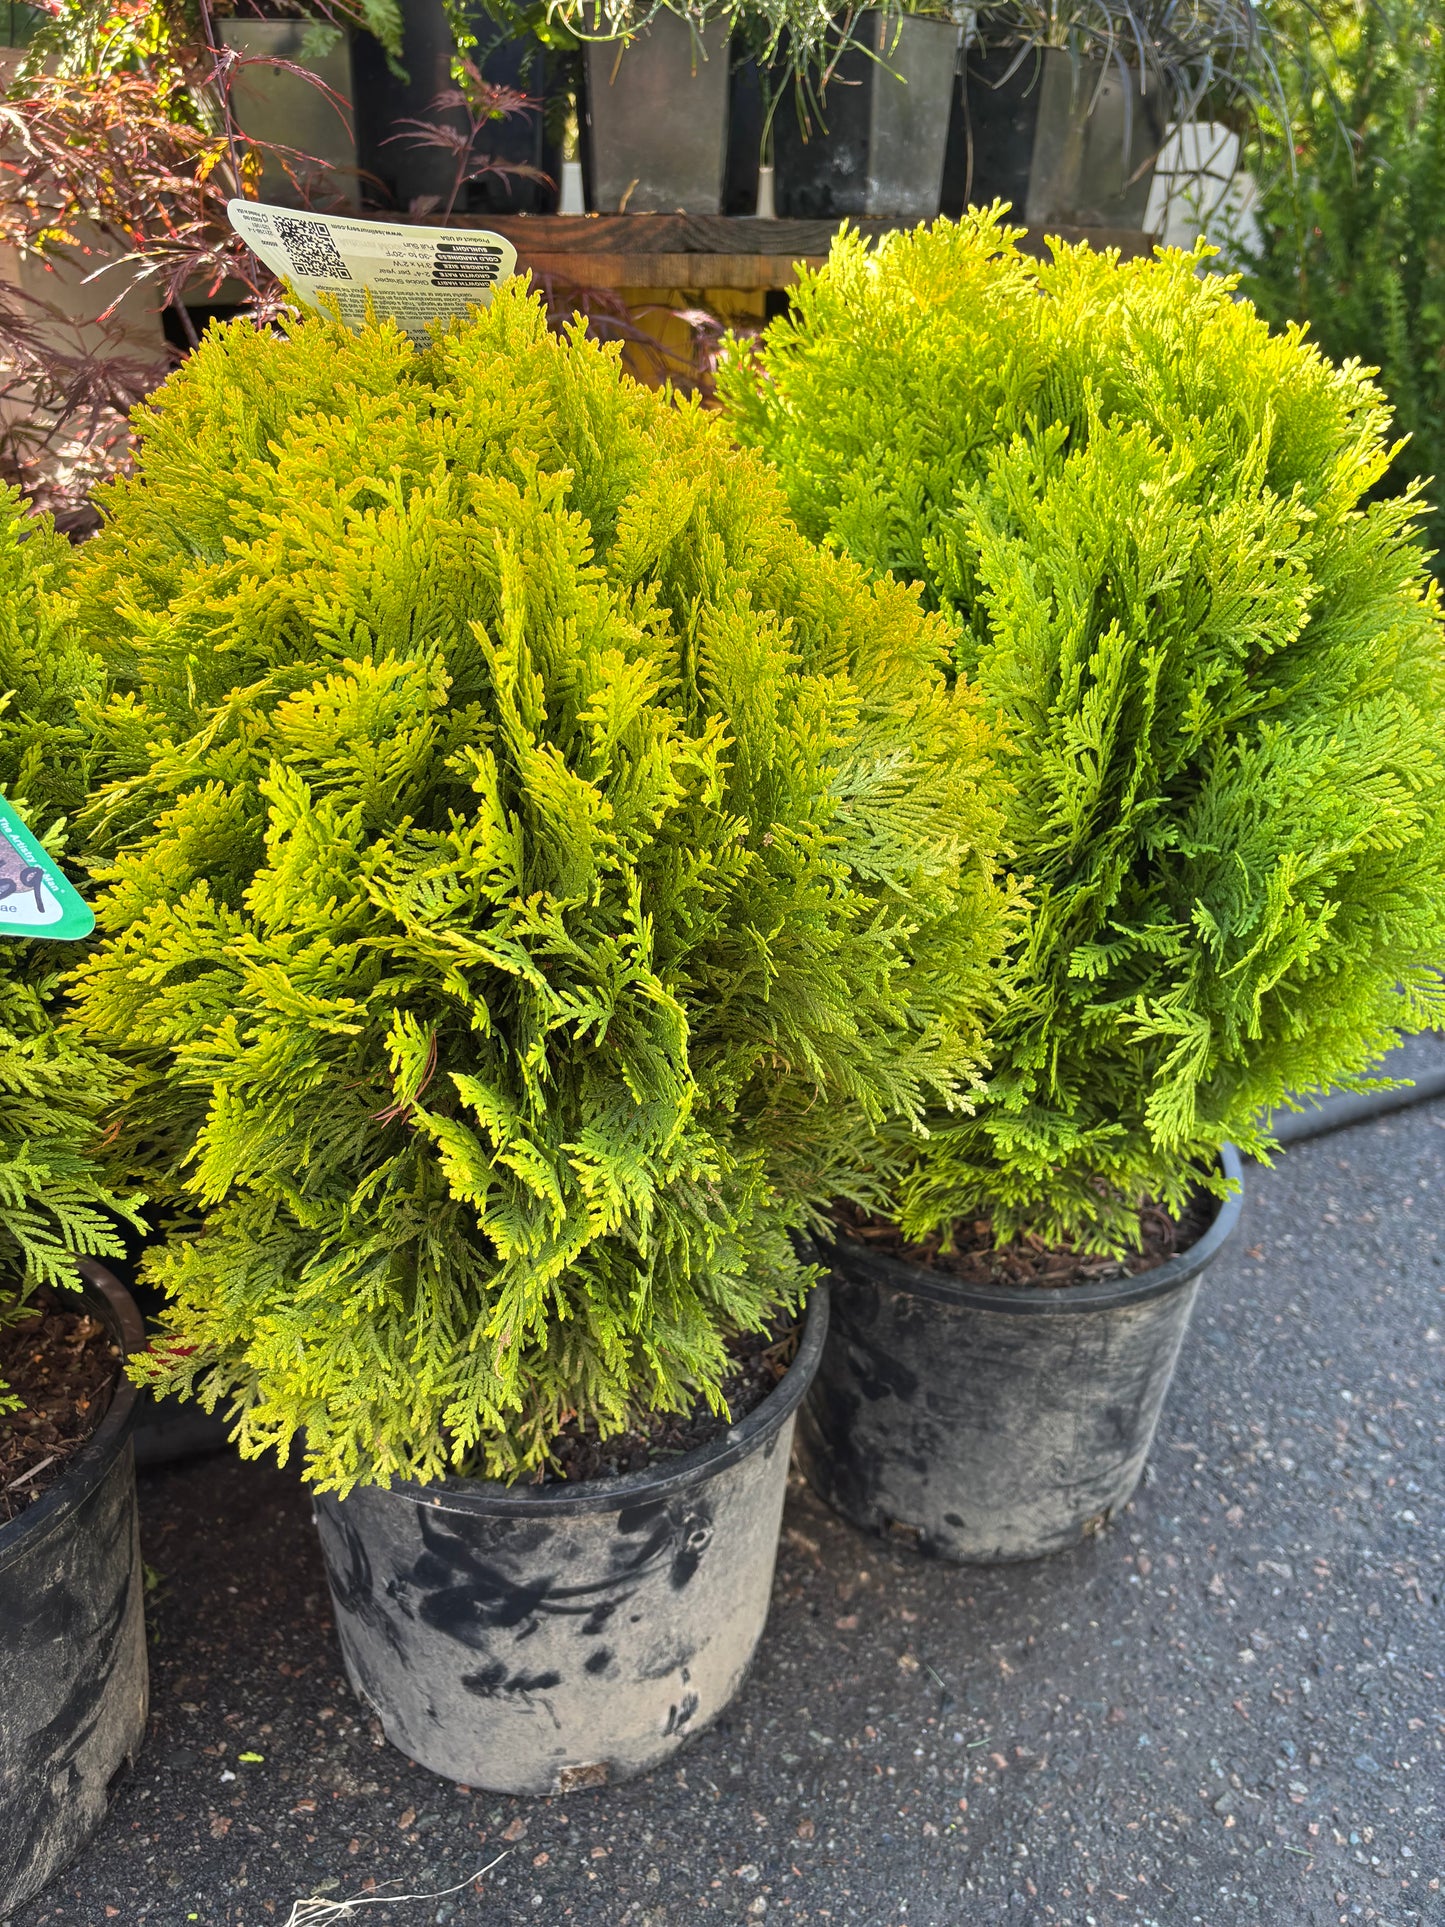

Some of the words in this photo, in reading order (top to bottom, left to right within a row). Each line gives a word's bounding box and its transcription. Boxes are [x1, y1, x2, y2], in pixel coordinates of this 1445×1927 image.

[0, 817, 12, 834] The
[10, 834, 37, 864] Artistry
[43, 873, 60, 892] Man
